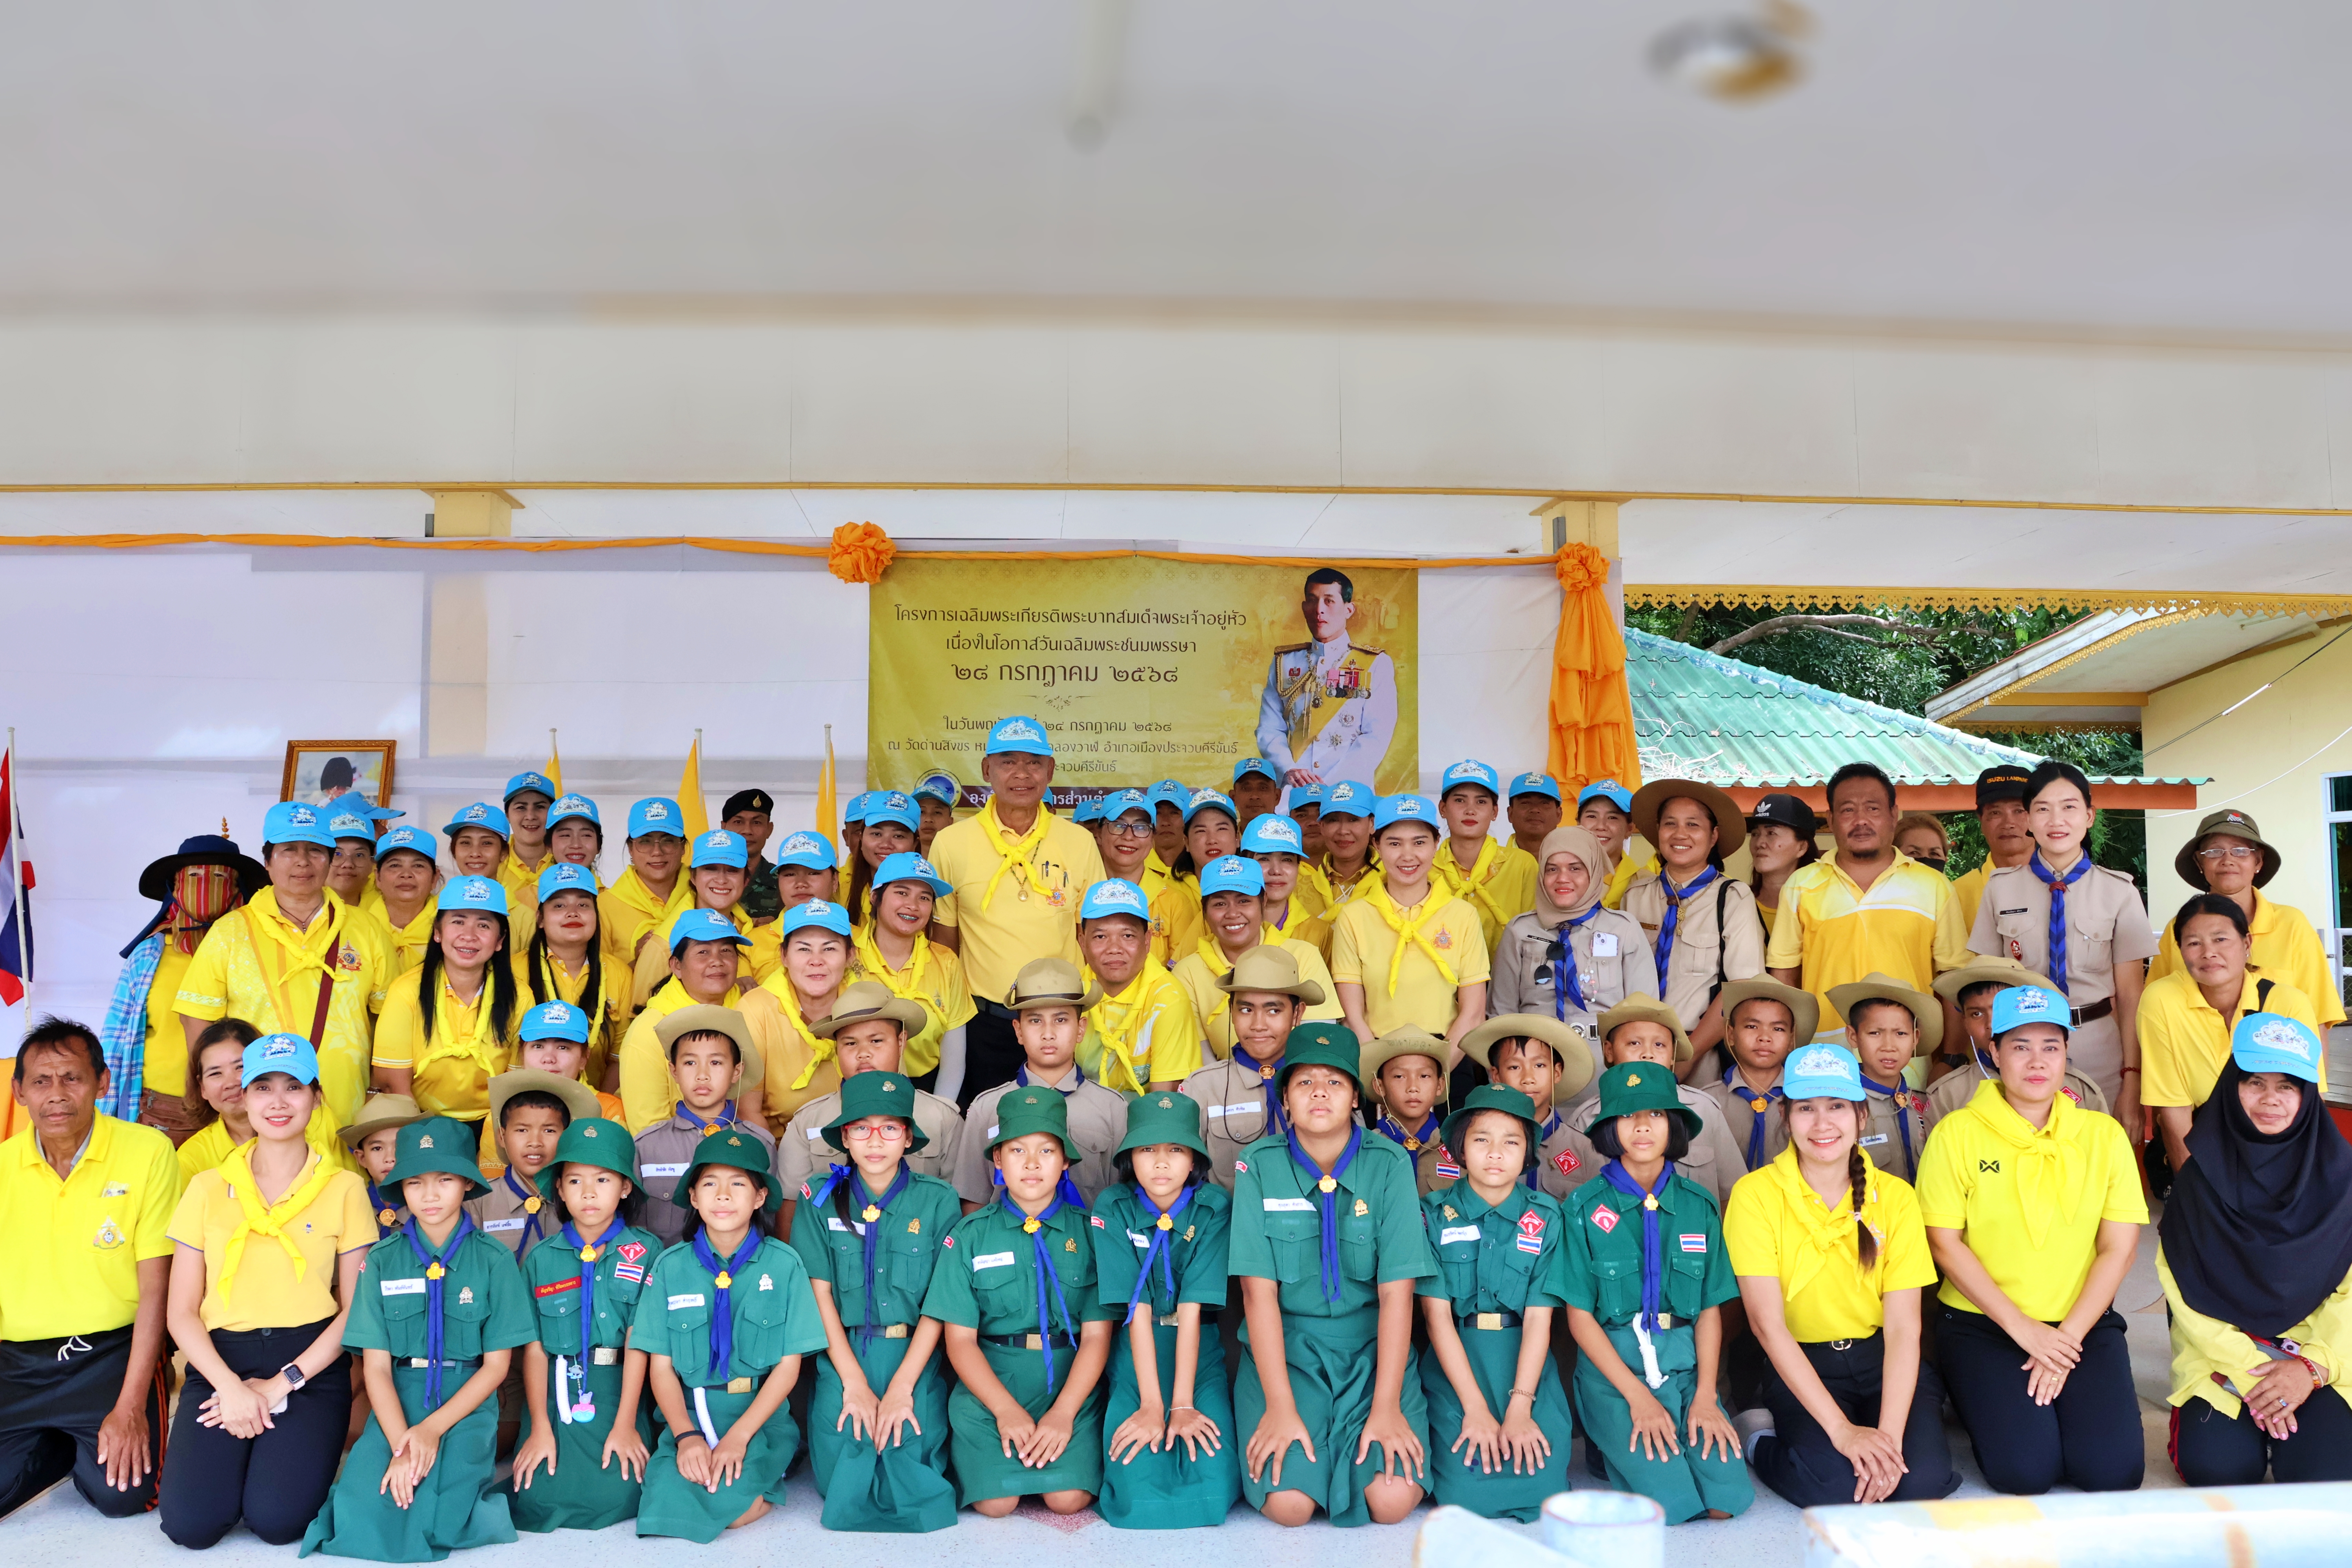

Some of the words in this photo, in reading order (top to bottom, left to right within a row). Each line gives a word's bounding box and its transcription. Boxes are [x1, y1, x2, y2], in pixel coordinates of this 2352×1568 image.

[894, 604, 1247, 630] โครงการเฉลิมพระเกียรติพระบาทสมเด็จพระเจ้าอยู่หัว
[946, 630, 1197, 652] เนื่องในโอกาสวันเฉลิมพระชนมพรรษา
[951, 664, 988, 680] ๒๘
[1000, 664, 1098, 687] กรกฎาคม
[1109, 666, 1178, 682] ๒๕๖๘
[1043, 721, 1064, 731] ๒๔
[1070, 721, 1127, 735] กรกฎาคม
[1132, 722, 1172, 731] ๒๕๖๘
[888, 741, 900, 750] ณ
[906, 738, 970, 751] วัดด่านสิงขร
[1104, 741, 1239, 754] อำเภอเมืองประจวบคีรีขันธ์
